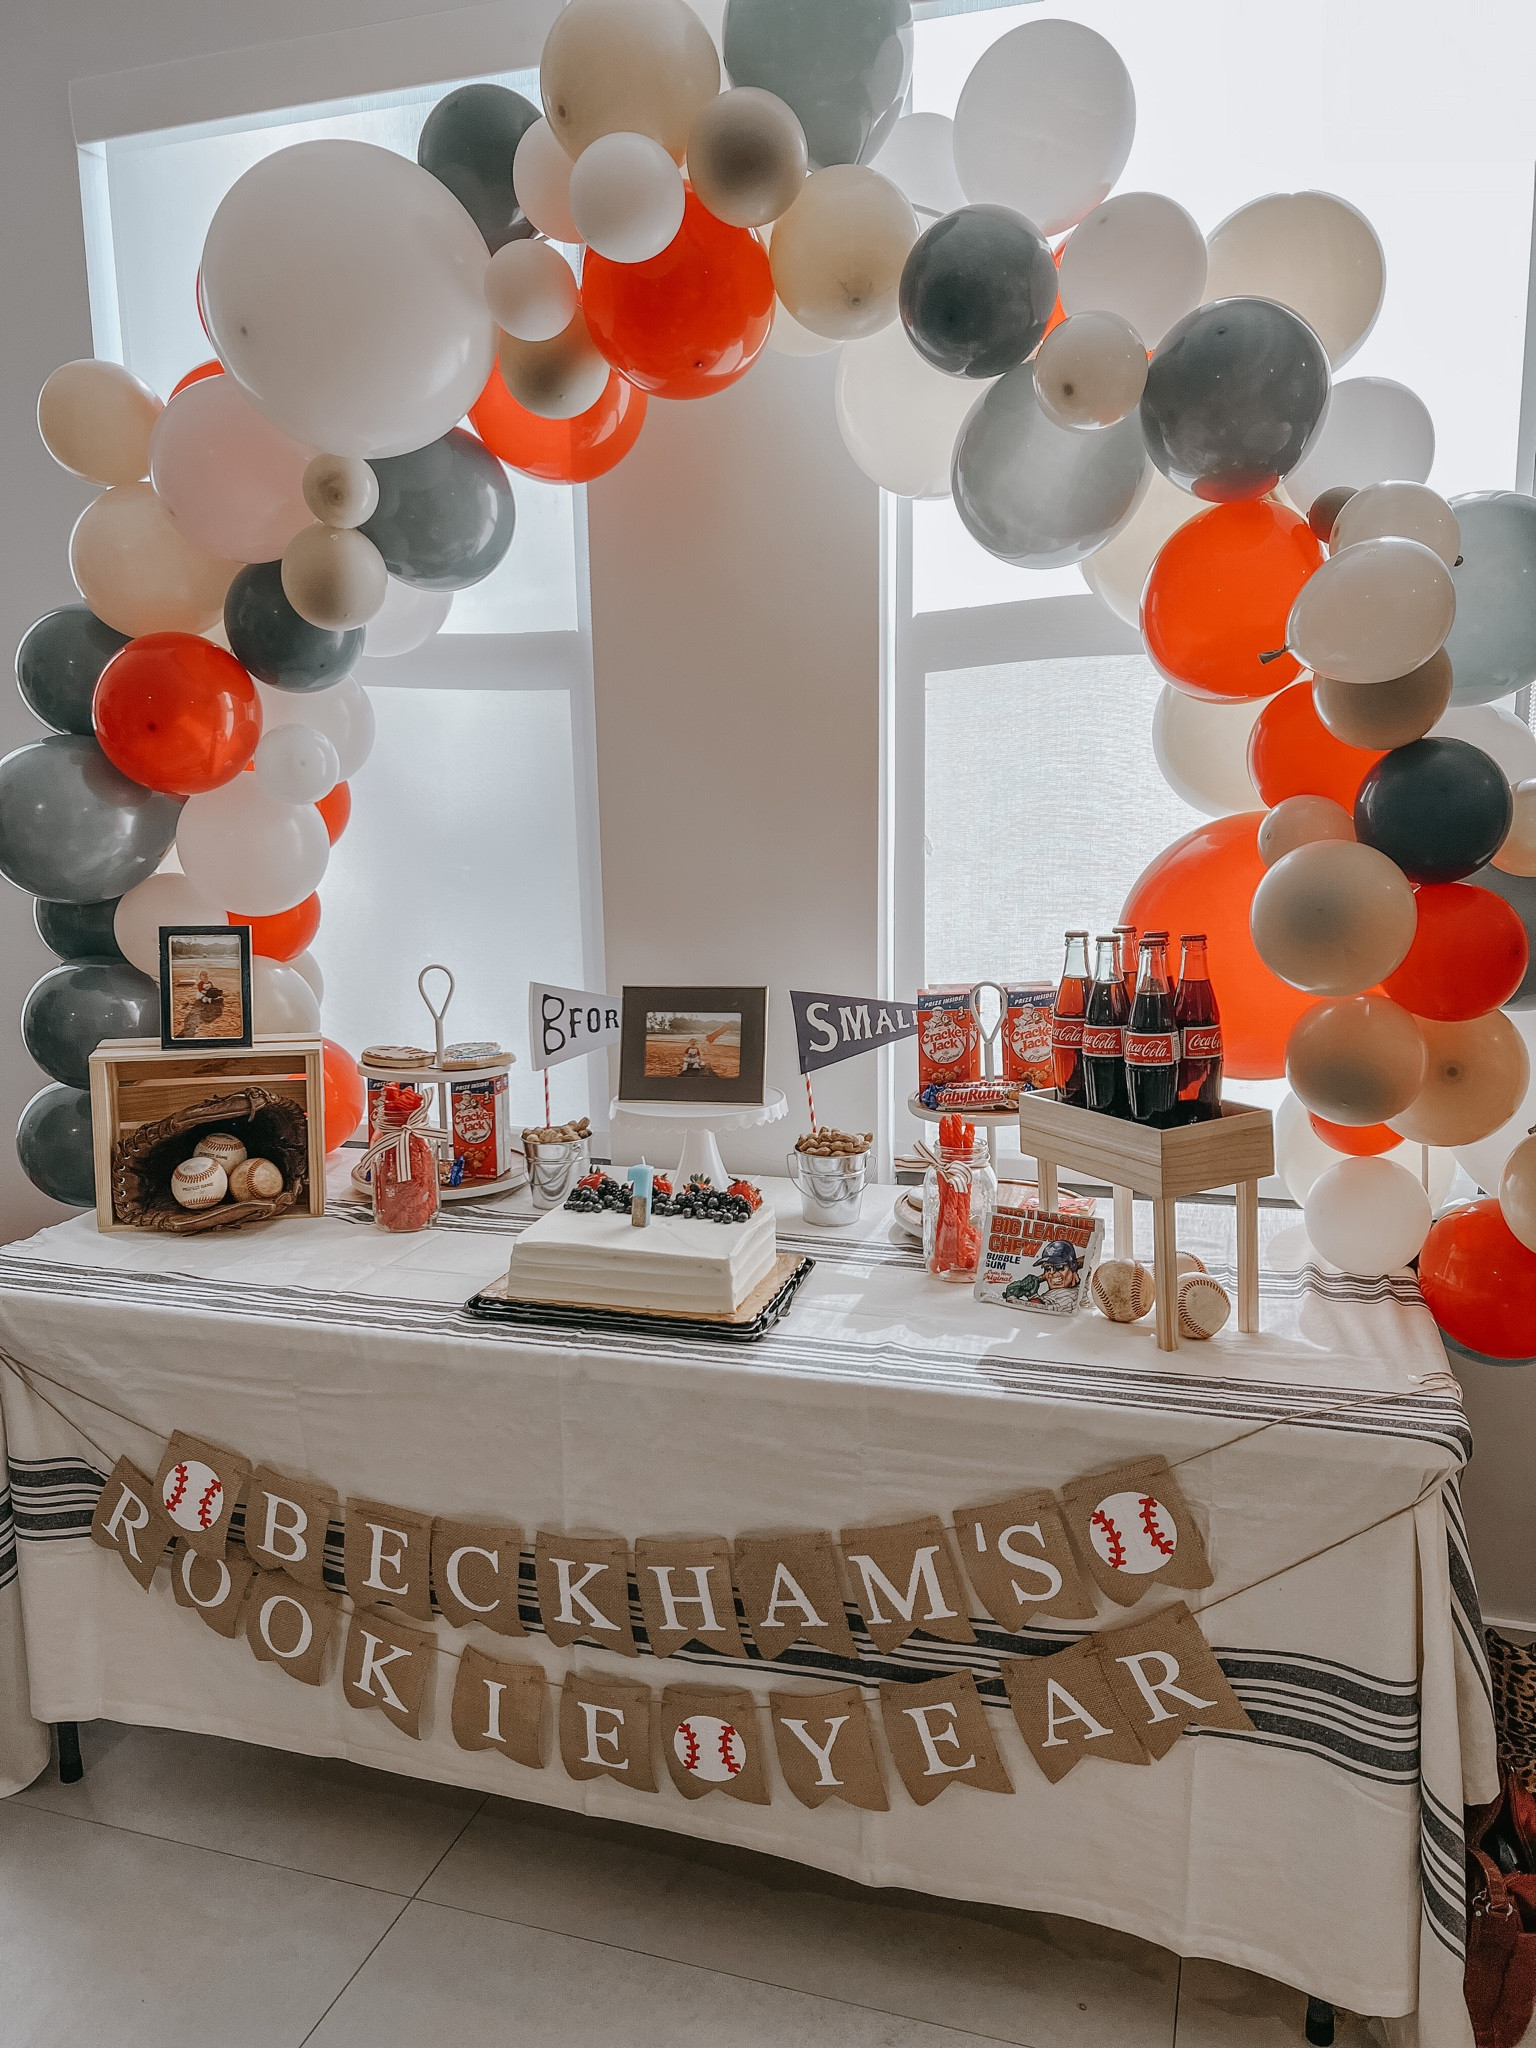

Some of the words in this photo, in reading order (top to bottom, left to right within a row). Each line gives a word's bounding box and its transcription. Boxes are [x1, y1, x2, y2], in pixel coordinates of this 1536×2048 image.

[924, 999, 943, 1008] PRIZE
[943, 995, 965, 1004] INSIDE!
[1014, 997, 1032, 1006] PRIZE
[921, 1027, 969, 1045] Cracker
[929, 1038, 959, 1055] Jack
[1019, 1037, 1050, 1053] Jack
[1126, 1039, 1169, 1058] Coca-Cola
[455, 1111, 494, 1125] Cracker
[461, 1120, 486, 1135] Jack
[990, 1215, 1022, 1236] BIG
[1022, 1220, 1092, 1248] LEAGUE
[989, 1234, 1043, 1258] CHEW
[986, 1252, 1021, 1265] BUBBLE
[983, 1273, 1013, 1282] Original
[256, 1491, 1064, 1631] BECKHAM'S
[101, 1482, 629, 1769] ROOKIE
[781, 1650, 1218, 1786] YEAR
